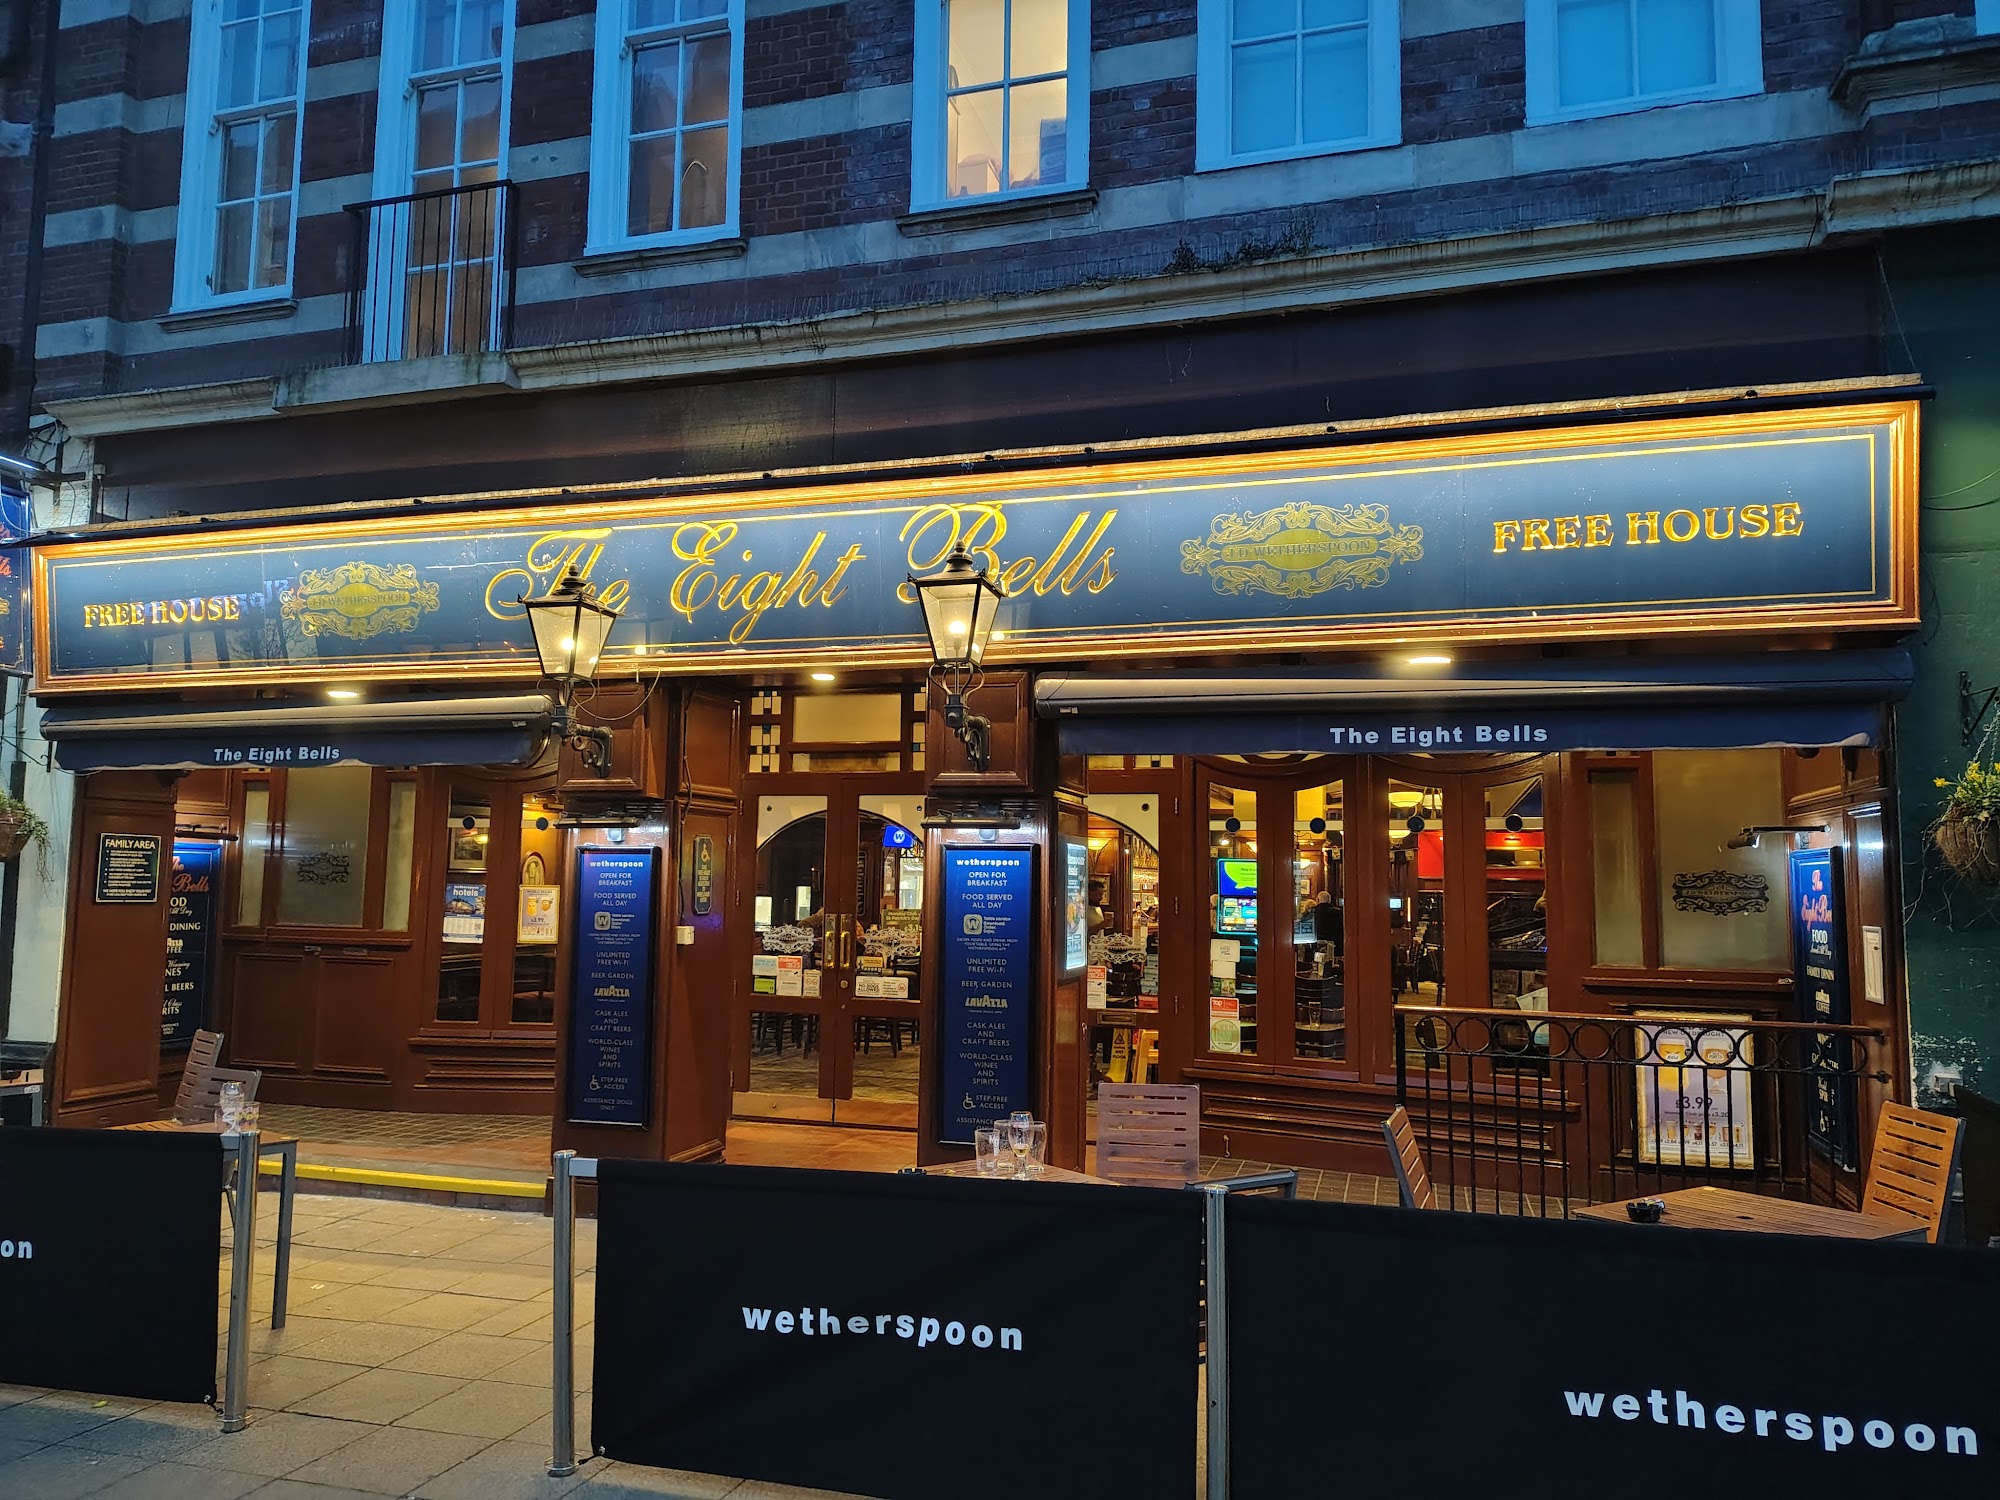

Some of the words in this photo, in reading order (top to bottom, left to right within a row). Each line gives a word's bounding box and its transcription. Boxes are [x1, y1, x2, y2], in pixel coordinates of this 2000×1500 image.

[1493, 513, 1615, 553] FREE
[1626, 502, 1804, 545] HOUSE
[1254, 540, 1371, 557] WETHERSPOON
[485, 527, 630, 620] The
[670, 521, 866, 644] Eight
[896, 502, 1118, 604] Bells
[84, 602, 145, 628] FREE
[150, 595, 241, 625] HOUSE
[1330, 727, 1379, 744] The
[1391, 726, 1463, 747] Eight
[1476, 725, 1548, 743] Bells
[214, 748, 242, 761] The
[248, 747, 292, 763] Eight
[299, 746, 340, 760] Bells
[105, 839, 134, 849] FAMILY
[133, 840, 156, 849] AREA
[589, 860, 643, 868] wetherspoon
[956, 858, 1020, 867] wetherspoon
[172, 873, 209, 893] Bells
[453, 889, 479, 897] hotels
[170, 922, 201, 931] DINING
[1812, 929, 1828, 944] FOOD
[966, 958, 1008, 966] UNLIMITED
[171, 982, 195, 991] BEERS
[593, 985, 631, 997] LAVAZZA
[965, 994, 1008, 1008] LAVAZZA
[588, 1038, 633, 1046] WORLD-CLASS
[959, 1052, 1013, 1061] WORLD-CLASS
[976, 1094, 1008, 1102] STEP-FREE
[956, 1116, 994, 1125] ASSISTANCE
[742, 1306, 1023, 1351] wetherspoon
[1563, 1388, 1979, 1456] wetherspoon
